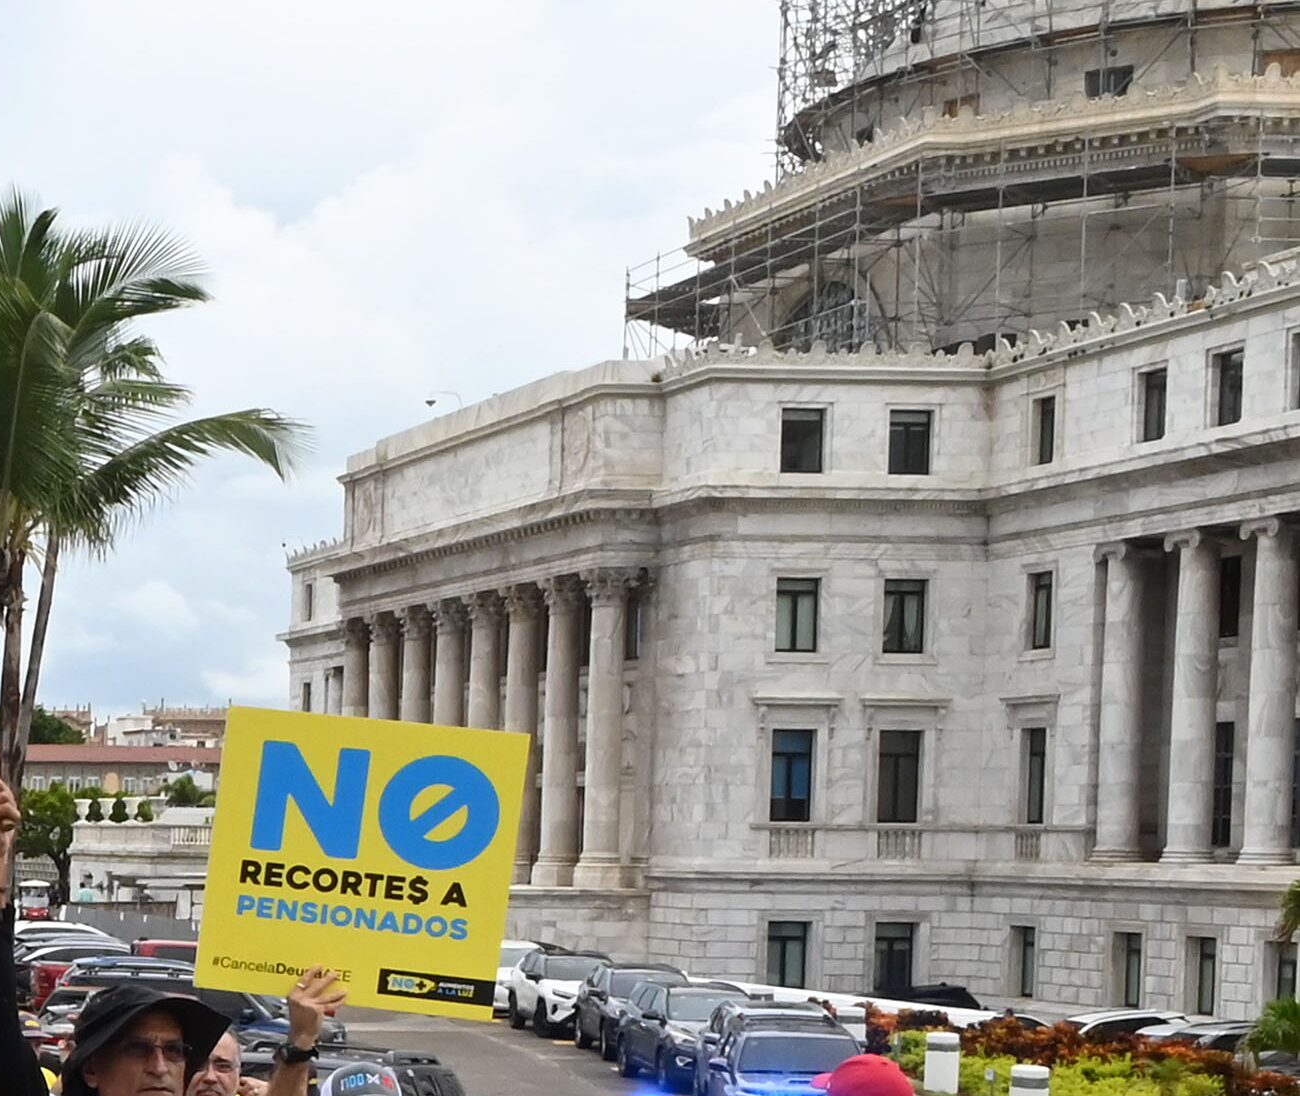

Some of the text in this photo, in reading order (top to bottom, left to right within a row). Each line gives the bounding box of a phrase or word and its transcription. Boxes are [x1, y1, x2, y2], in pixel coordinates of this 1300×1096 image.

[250, 739, 500, 871] NO
[238, 859, 467, 908] RECORTE$ A
[235, 894, 469, 940] PENSIONADOS
